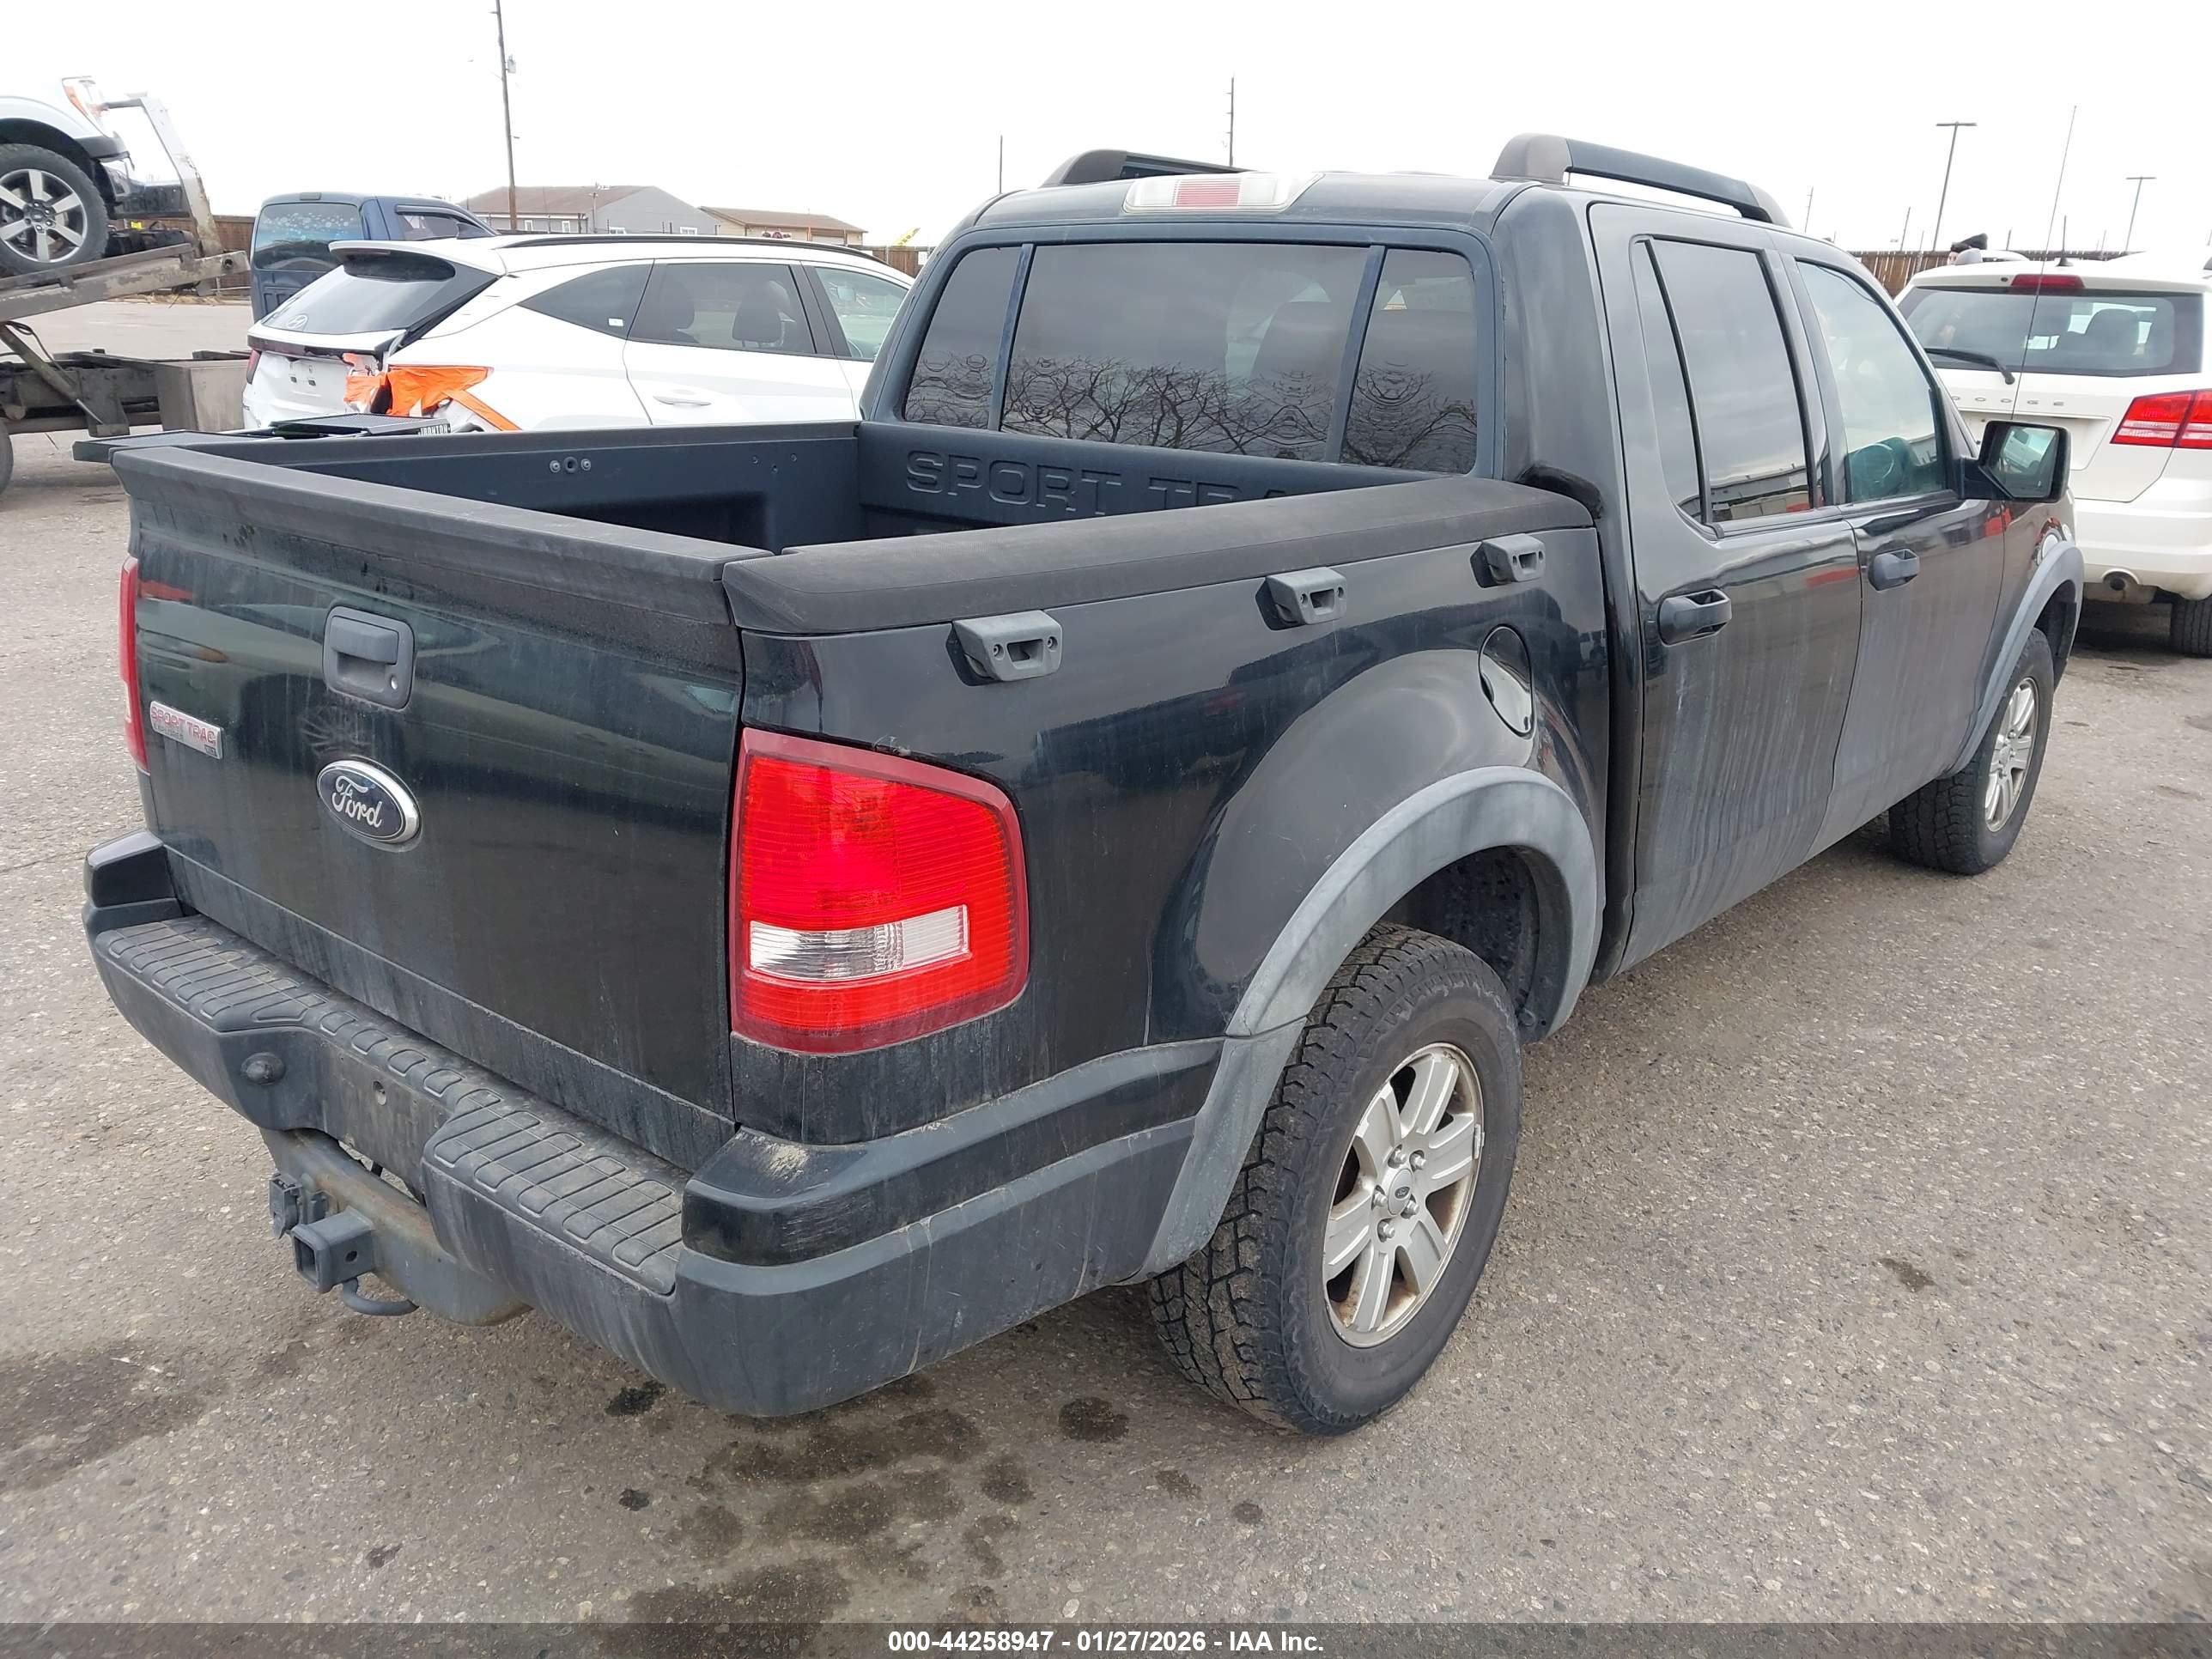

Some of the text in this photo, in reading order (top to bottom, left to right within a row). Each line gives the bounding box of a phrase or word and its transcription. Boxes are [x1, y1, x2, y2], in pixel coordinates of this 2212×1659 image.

[906, 449, 1121, 515] SPORT
[149, 706, 185, 733] SPORT
[186, 720, 216, 746] TRAC
[331, 775, 383, 828] Ford
